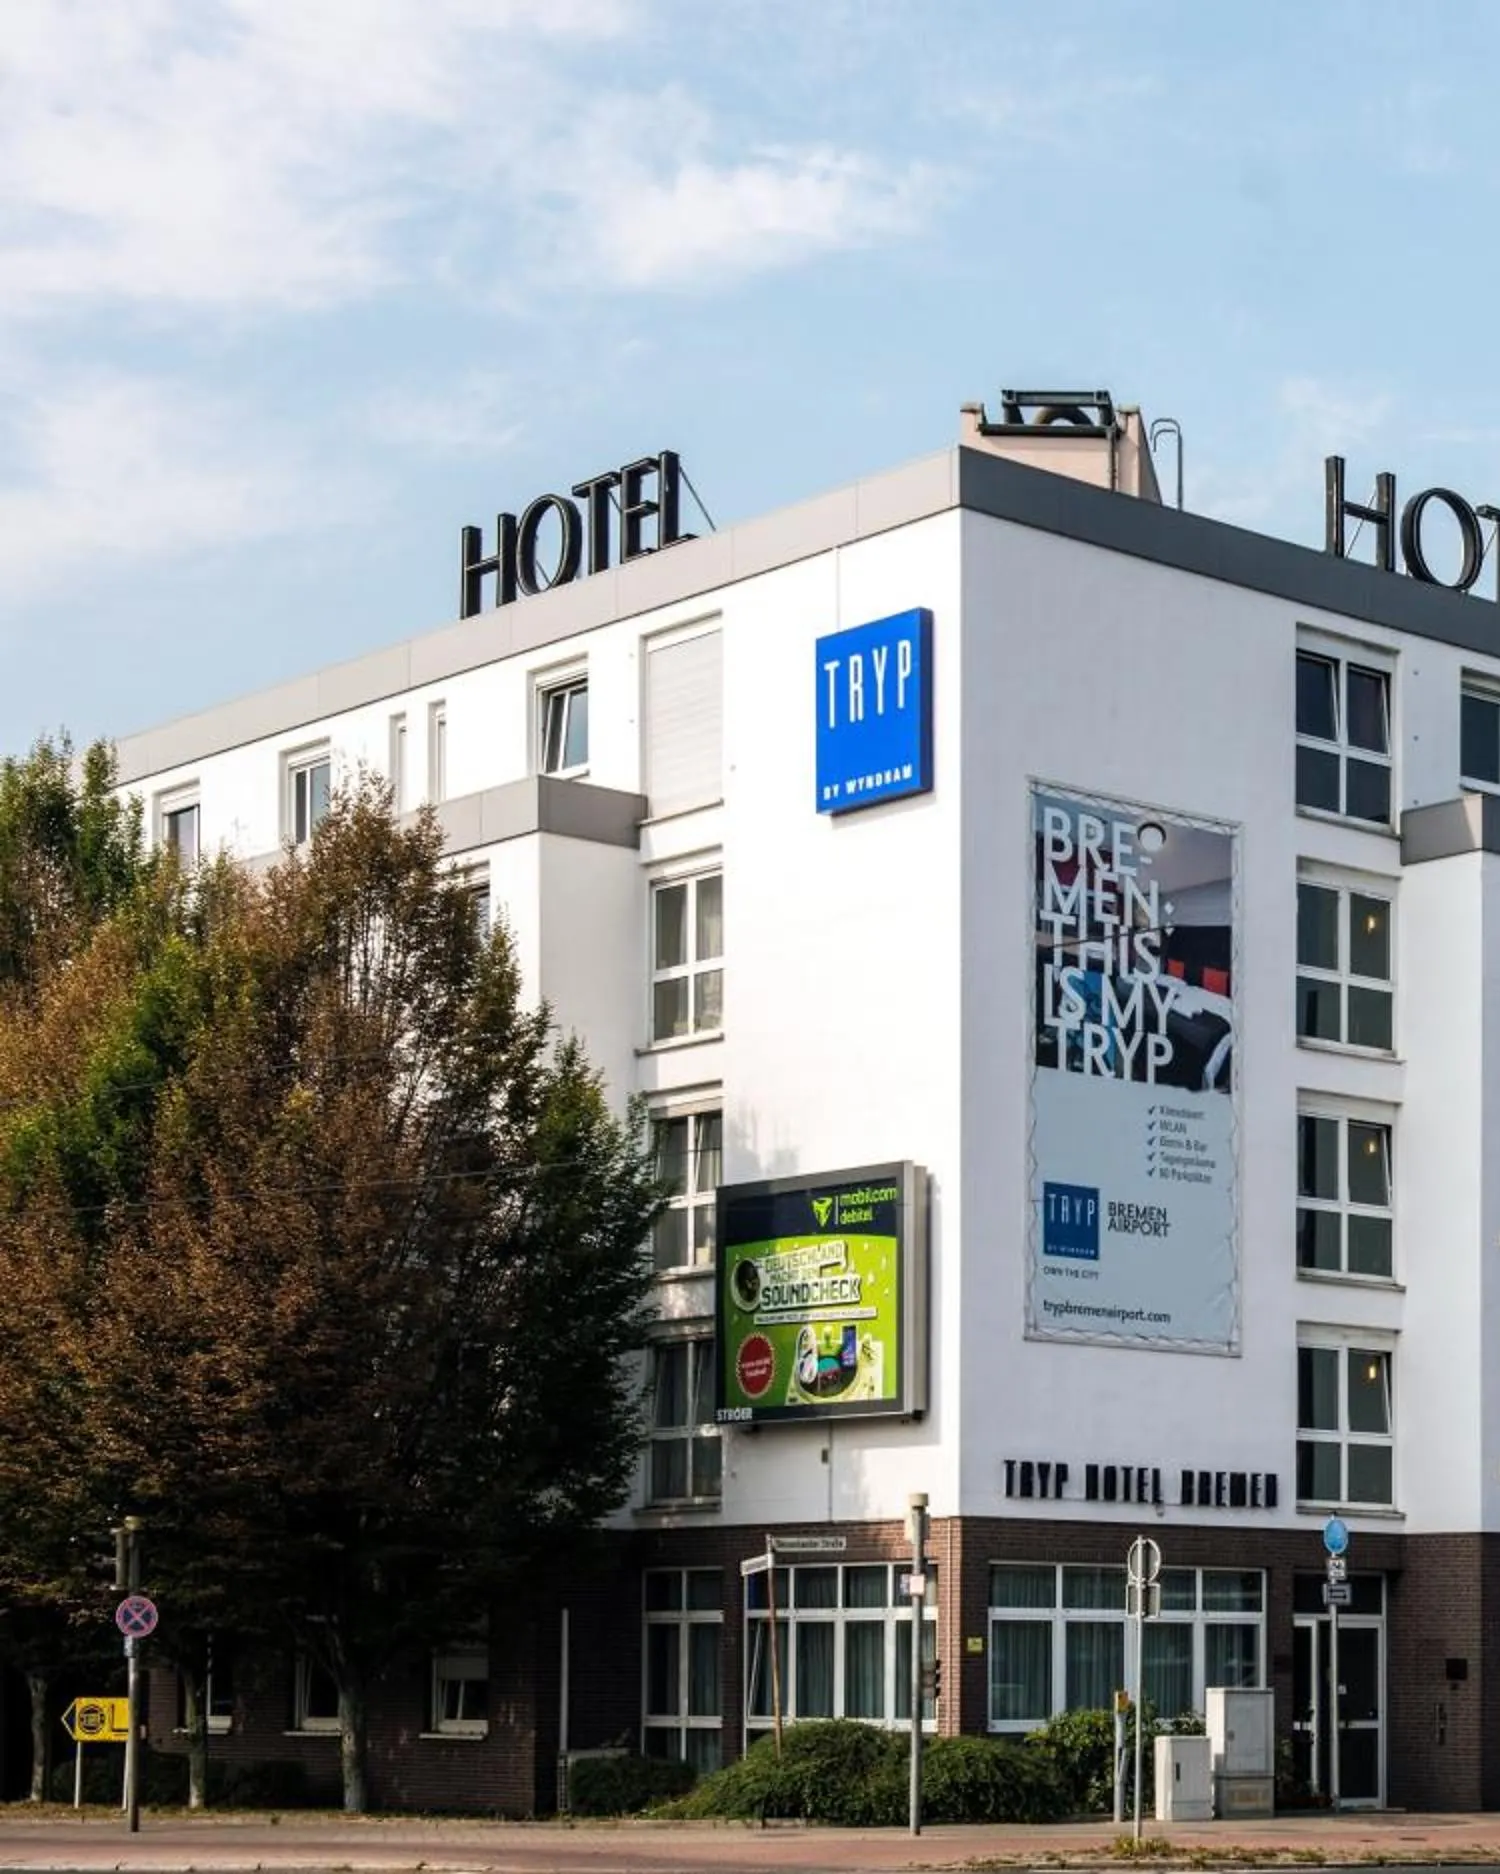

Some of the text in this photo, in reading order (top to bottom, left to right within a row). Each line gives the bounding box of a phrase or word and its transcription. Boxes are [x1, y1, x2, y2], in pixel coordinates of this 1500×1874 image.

[460, 450, 699, 620] HOTEL
[824, 639, 911, 729] TRYP
[823, 764, 913, 801] BY WYNDHAM
[1040, 908, 1161, 983] THIS
[1043, 963, 1181, 1036] IS MY
[1044, 1016, 1174, 1085] TRYP
[1048, 1193, 1096, 1226] TRYP
[1107, 1201, 1168, 1222] BREMEN
[1107, 1219, 1171, 1238] AIRPORT
[761, 1277, 860, 1307] SOUNDCHECK
[1043, 1298, 1172, 1325] trypbremenairport.com
[1003, 1459, 1279, 1508] TRYP HOTEL BREMEN
